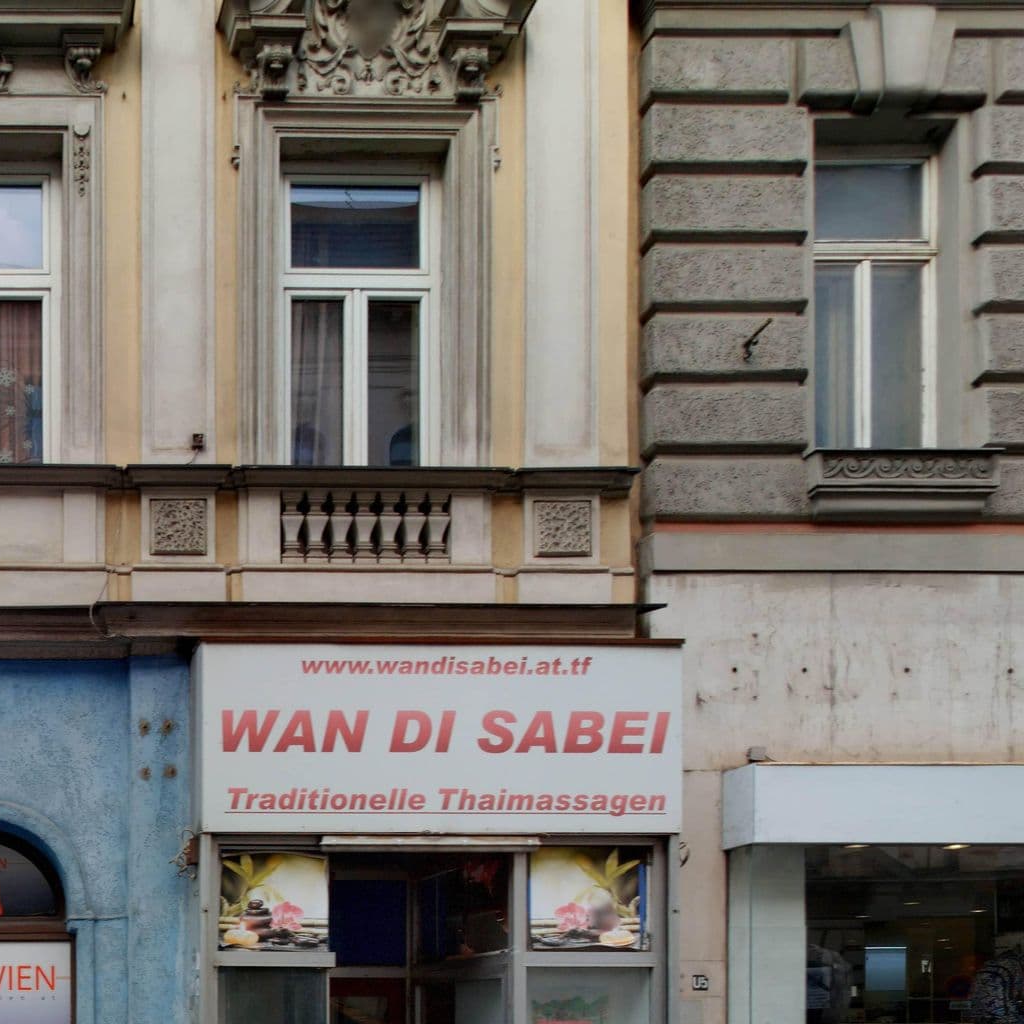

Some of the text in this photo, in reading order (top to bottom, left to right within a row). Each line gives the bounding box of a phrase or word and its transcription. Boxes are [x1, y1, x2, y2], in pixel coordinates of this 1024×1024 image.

[301, 656, 593, 676] www.wandisabei.at.tf
[221, 709, 671, 754] WAN DI SABEI
[227, 787, 666, 817] Traditionelle Thaimassagen
